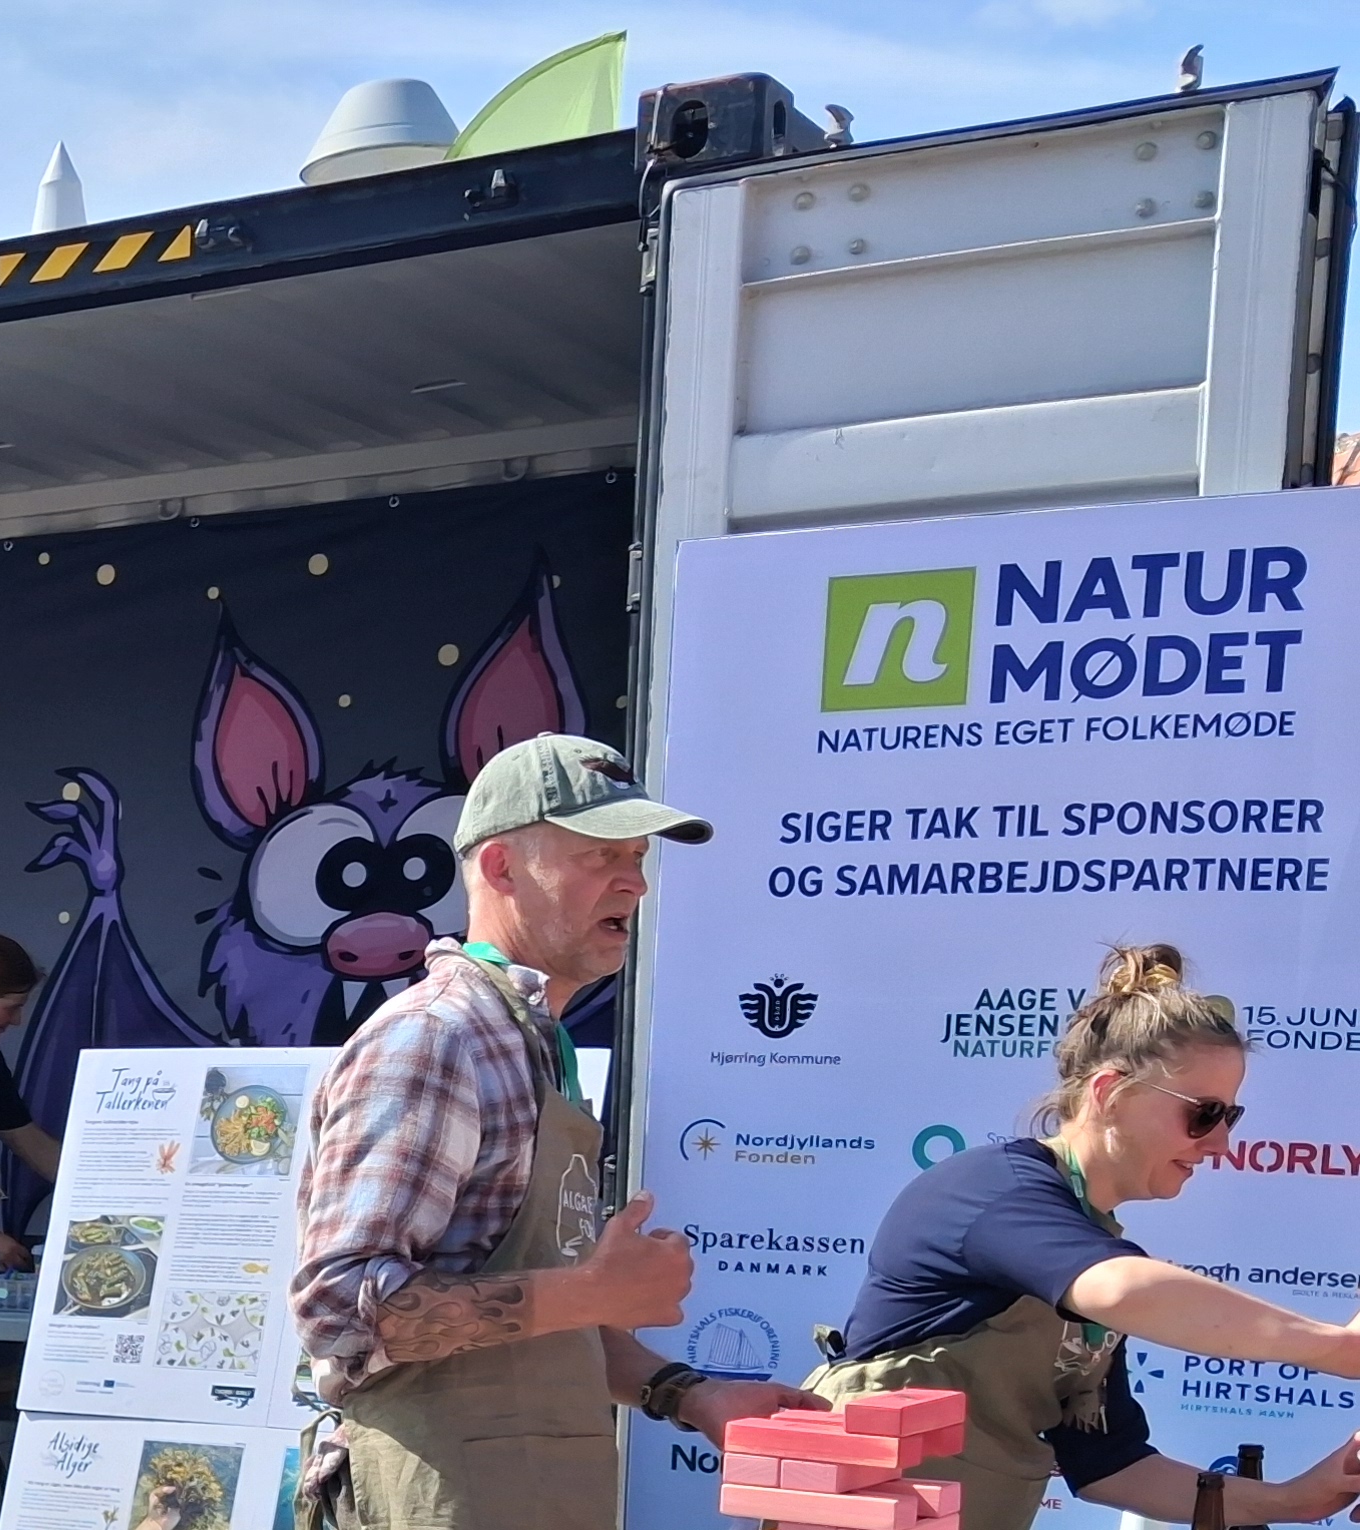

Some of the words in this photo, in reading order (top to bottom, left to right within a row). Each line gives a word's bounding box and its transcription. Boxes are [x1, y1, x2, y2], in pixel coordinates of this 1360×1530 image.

[994, 546, 1309, 626] NATUR
[989, 629, 1304, 704] MØDET
[817, 722, 983, 754] NATURENS
[994, 717, 1075, 746] EGET
[1084, 710, 1297, 742] FOLKEMØDE
[779, 809, 892, 844] SIGER
[905, 806, 980, 840] TAK
[993, 804, 1048, 838] TIL
[1061, 799, 1324, 836] SPONSORER
[768, 865, 823, 898] OG
[834, 857, 1330, 897] SAMARBEJDSPARTNERE
[974, 988, 1058, 1011] AAGE
[940, 1013, 1060, 1043] JENSEN
[710, 1051, 766, 1067] Hjørring
[769, 1051, 841, 1066] Kommune
[112, 1067, 143, 1095] Tang
[142, 1069, 163, 1095] på
[95, 1090, 168, 1114] Tallerkenen
[735, 1132, 876, 1153] Nordjyllands
[734, 1149, 817, 1166] Fonden
[683, 1225, 866, 1256] Sparekassen
[718, 1260, 827, 1276] DANMARK
[1167, 1258, 1240, 1283] rogh
[687, 1312, 717, 1364] HIRTSHALS
[1184, 1355, 1266, 1377] PORT
[1182, 1380, 1355, 1409] HIRTSHALS
[1180, 1404, 1253, 1416] HIRTSHALS
[47, 1431, 100, 1460] Alsidige
[54, 1452, 93, 1479] Alger
